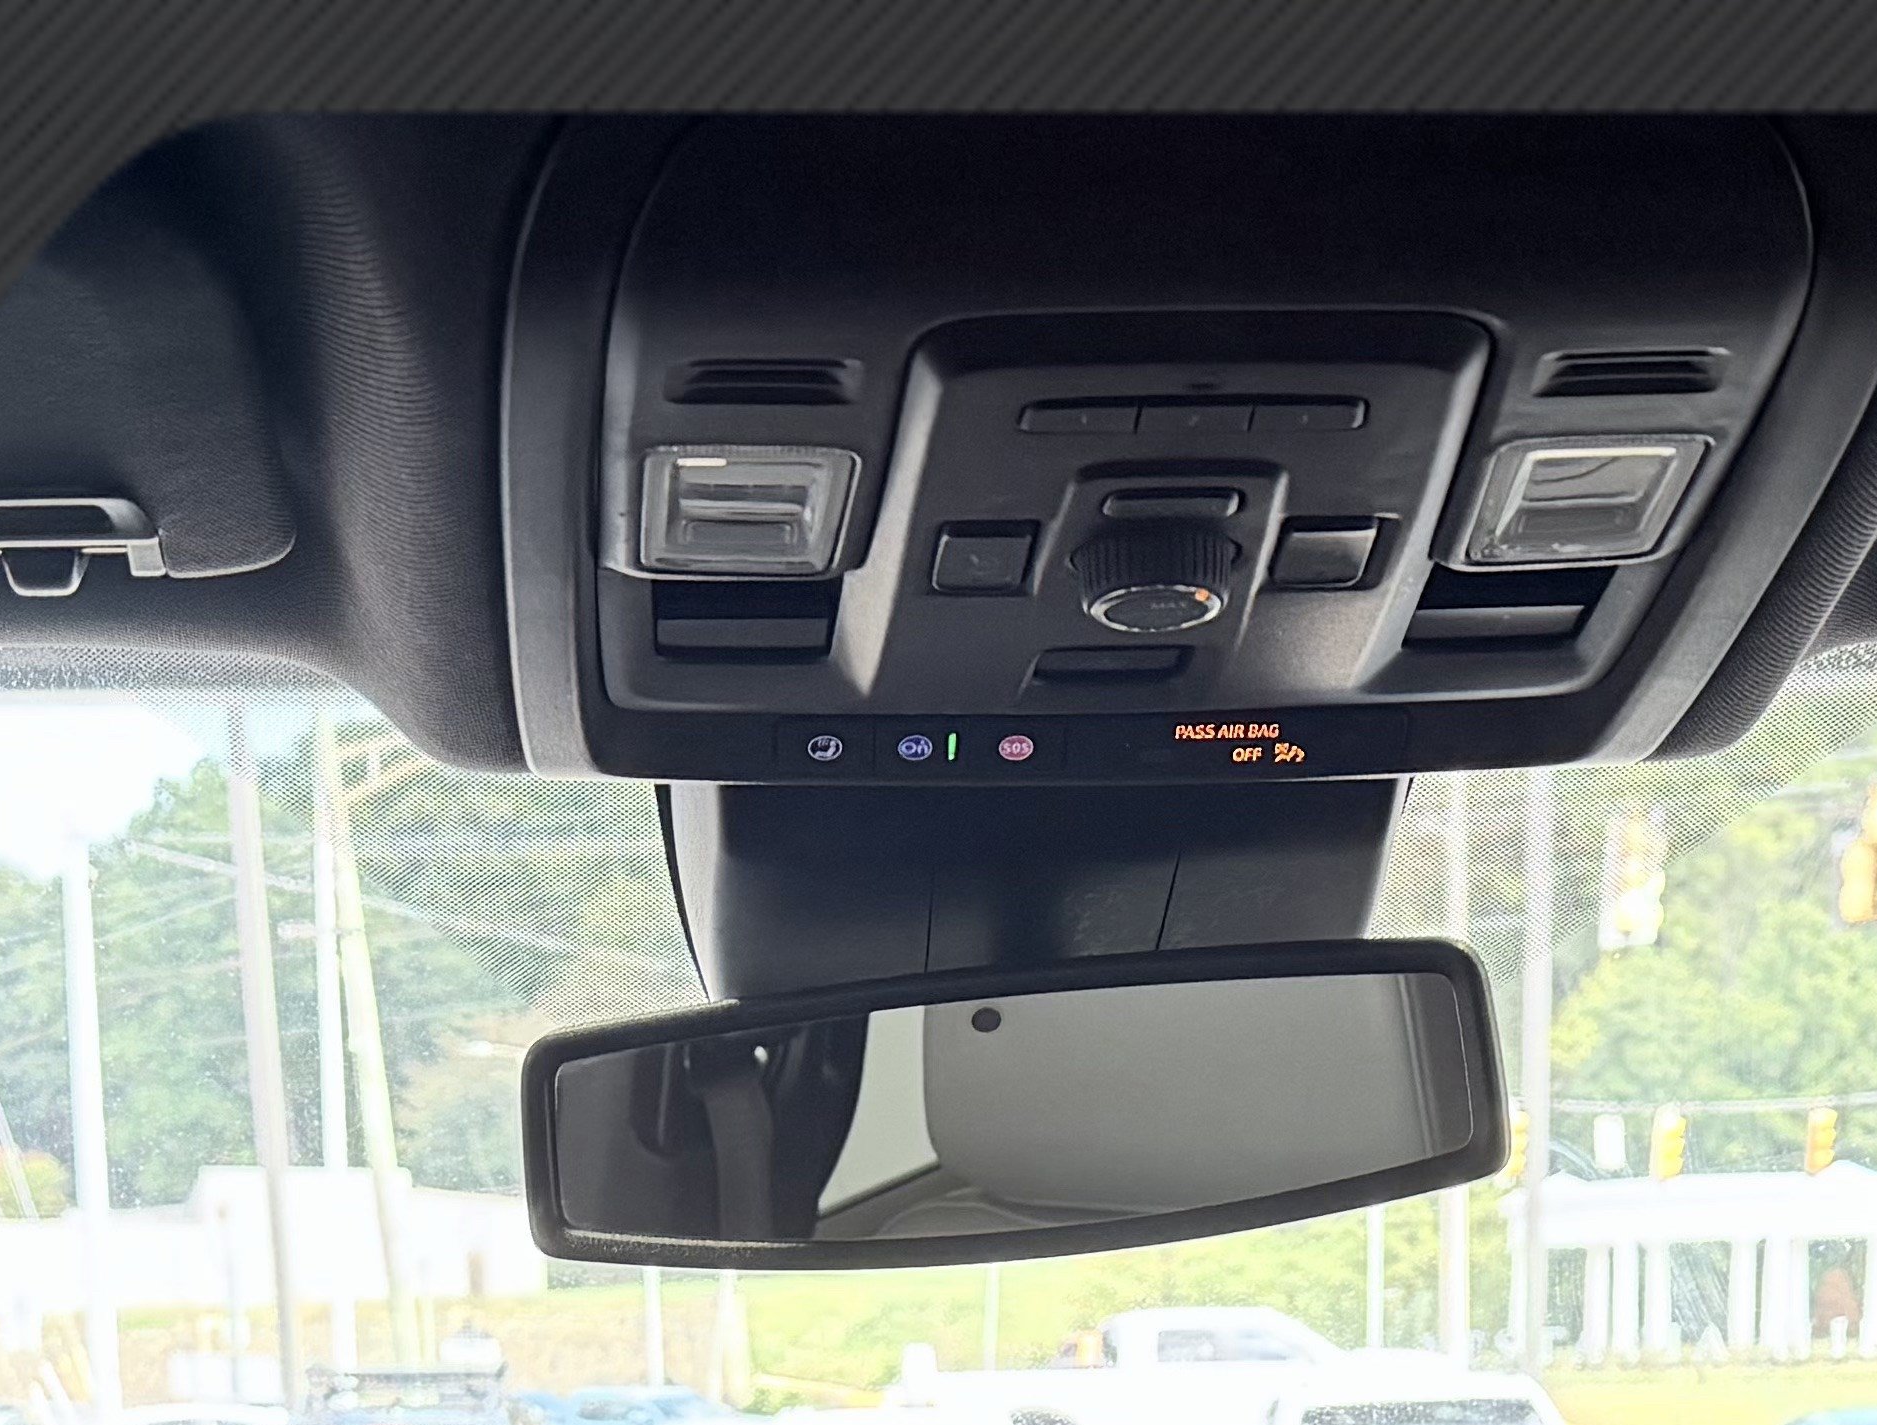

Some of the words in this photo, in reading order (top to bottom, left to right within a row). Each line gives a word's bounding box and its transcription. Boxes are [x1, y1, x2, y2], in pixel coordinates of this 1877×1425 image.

[1175, 725, 1215, 739] PASS
[1217, 724, 1246, 738] AIR
[1247, 723, 1279, 738] BAG
[1232, 746, 1263, 762] OFF
